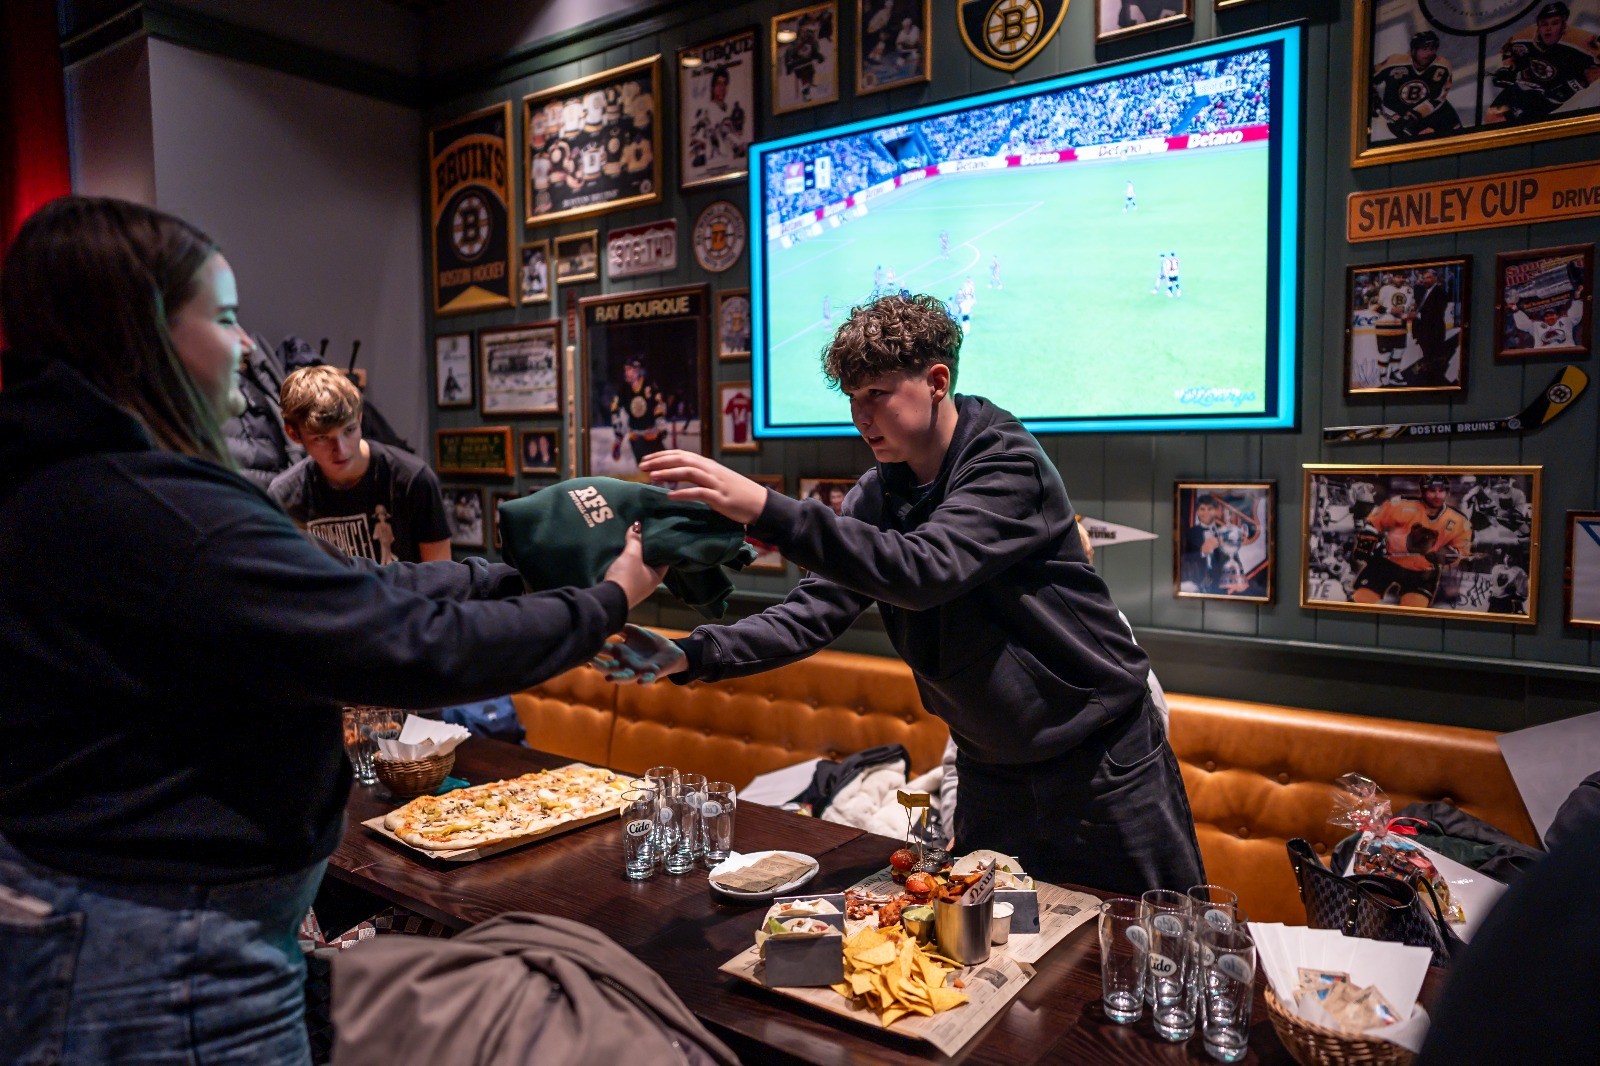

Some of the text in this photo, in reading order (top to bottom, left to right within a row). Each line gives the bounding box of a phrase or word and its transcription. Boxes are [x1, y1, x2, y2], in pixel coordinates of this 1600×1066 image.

[1187, 130, 1243, 149] Betano
[436, 143, 504, 205] BRUINS
[1358, 186, 1474, 233] STANLEY
[1480, 178, 1539, 219] CUP
[472, 260, 506, 283] HOCKEY
[596, 303, 620, 322] RAY
[623, 296, 690, 319] BOURQUE
[1410, 421, 1496, 435] BOSTON BRUINS
[574, 485, 615, 524] RFS
[628, 820, 651, 834] Cido
